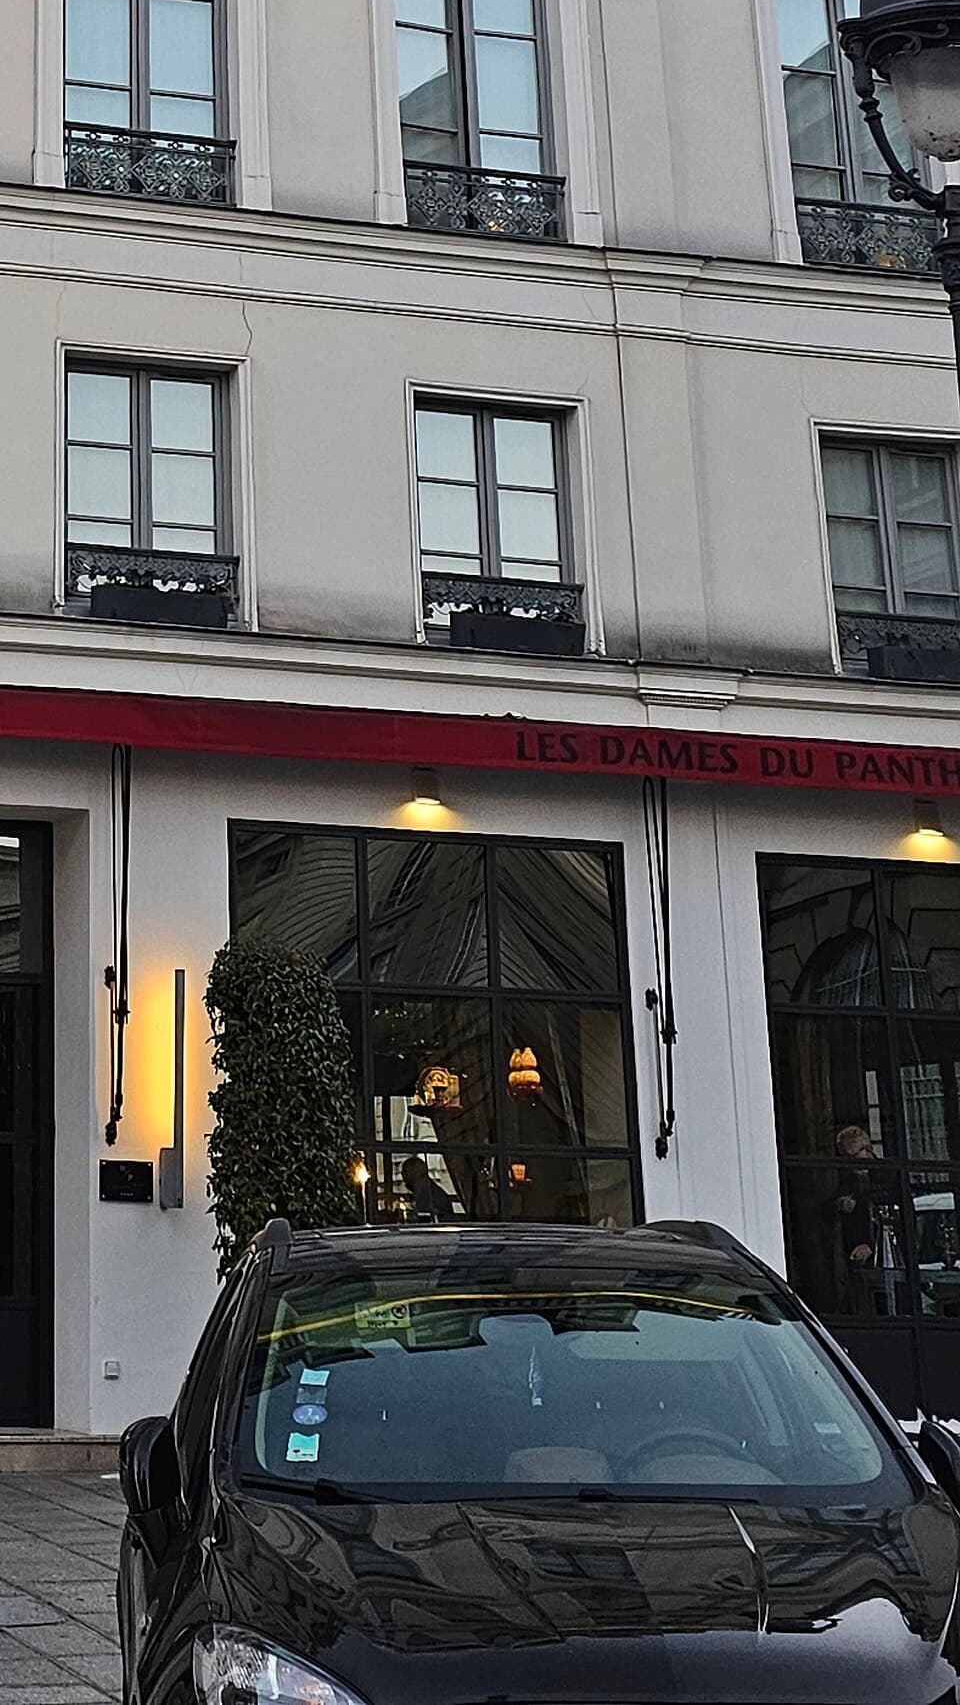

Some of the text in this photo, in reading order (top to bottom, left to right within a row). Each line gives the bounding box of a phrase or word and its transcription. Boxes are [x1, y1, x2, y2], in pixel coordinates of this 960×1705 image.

[515, 731, 578, 763] LES
[600, 735, 739, 774] DAMES
[760, 747, 814, 778] DU
